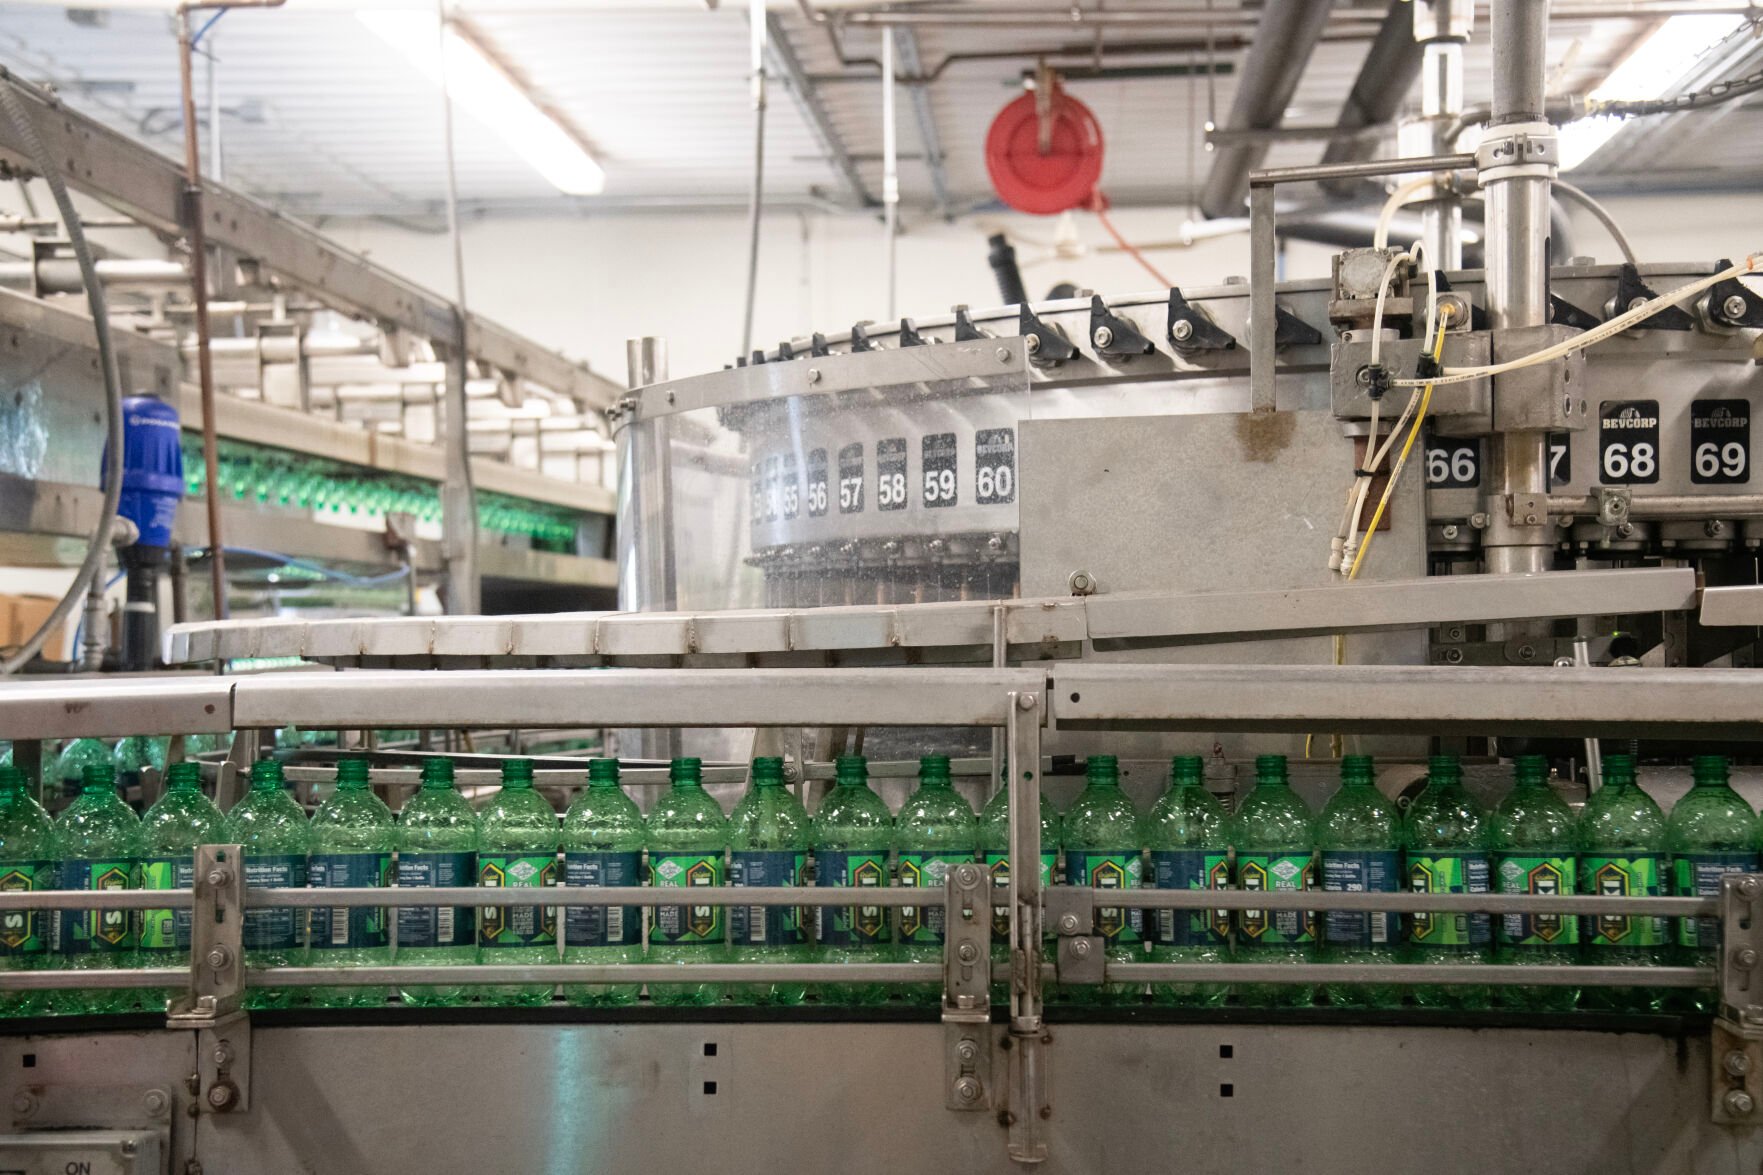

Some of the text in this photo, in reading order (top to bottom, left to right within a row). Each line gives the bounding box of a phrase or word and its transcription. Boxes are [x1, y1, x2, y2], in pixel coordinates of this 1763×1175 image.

[1602, 417, 1657, 429] BEVCORP
[1694, 417, 1748, 428] BEVCORP
[1427, 448, 1476, 482] 66
[1550, 445, 1567, 479] 7
[1603, 442, 1655, 478] 68
[1695, 442, 1746, 477] 69
[808, 481, 827, 511] 56
[840, 477, 863, 508] 57
[879, 473, 905, 505] 58
[924, 469, 955, 501] 59
[978, 465, 1012, 497] 60
[784, 485, 798, 513] 55
[660, 880, 678, 888] REAL
[928, 879, 945, 887] REA
[1275, 880, 1296, 888] REAL
[65, 1162, 91, 1175] ON
